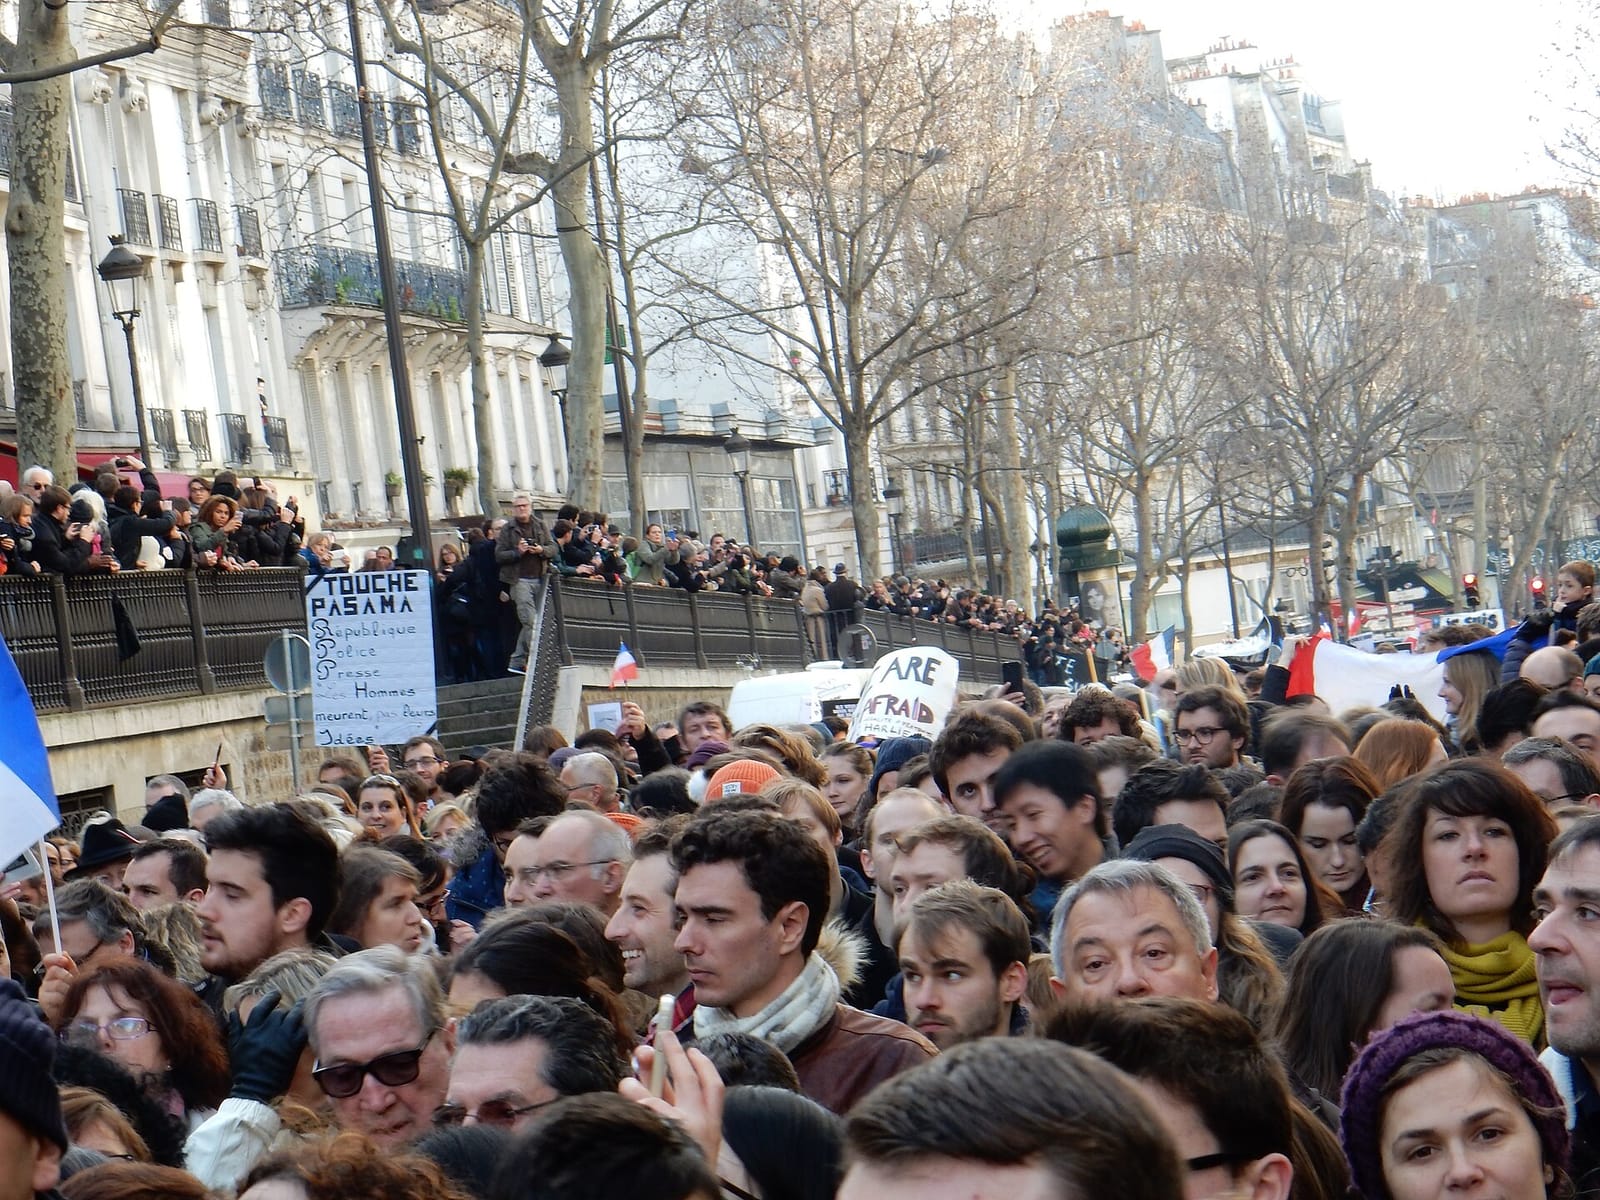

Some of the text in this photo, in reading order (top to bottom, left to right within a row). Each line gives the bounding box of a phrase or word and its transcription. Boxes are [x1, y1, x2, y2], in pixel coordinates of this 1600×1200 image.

[323, 573, 418, 595] TOUCHE
[312, 618, 417, 641] République
[315, 638, 377, 659] Police
[316, 659, 381, 680] Presse
[880, 656, 941, 686] ARE
[354, 682, 416, 698] Hommes
[863, 694, 934, 724] AFRAID
